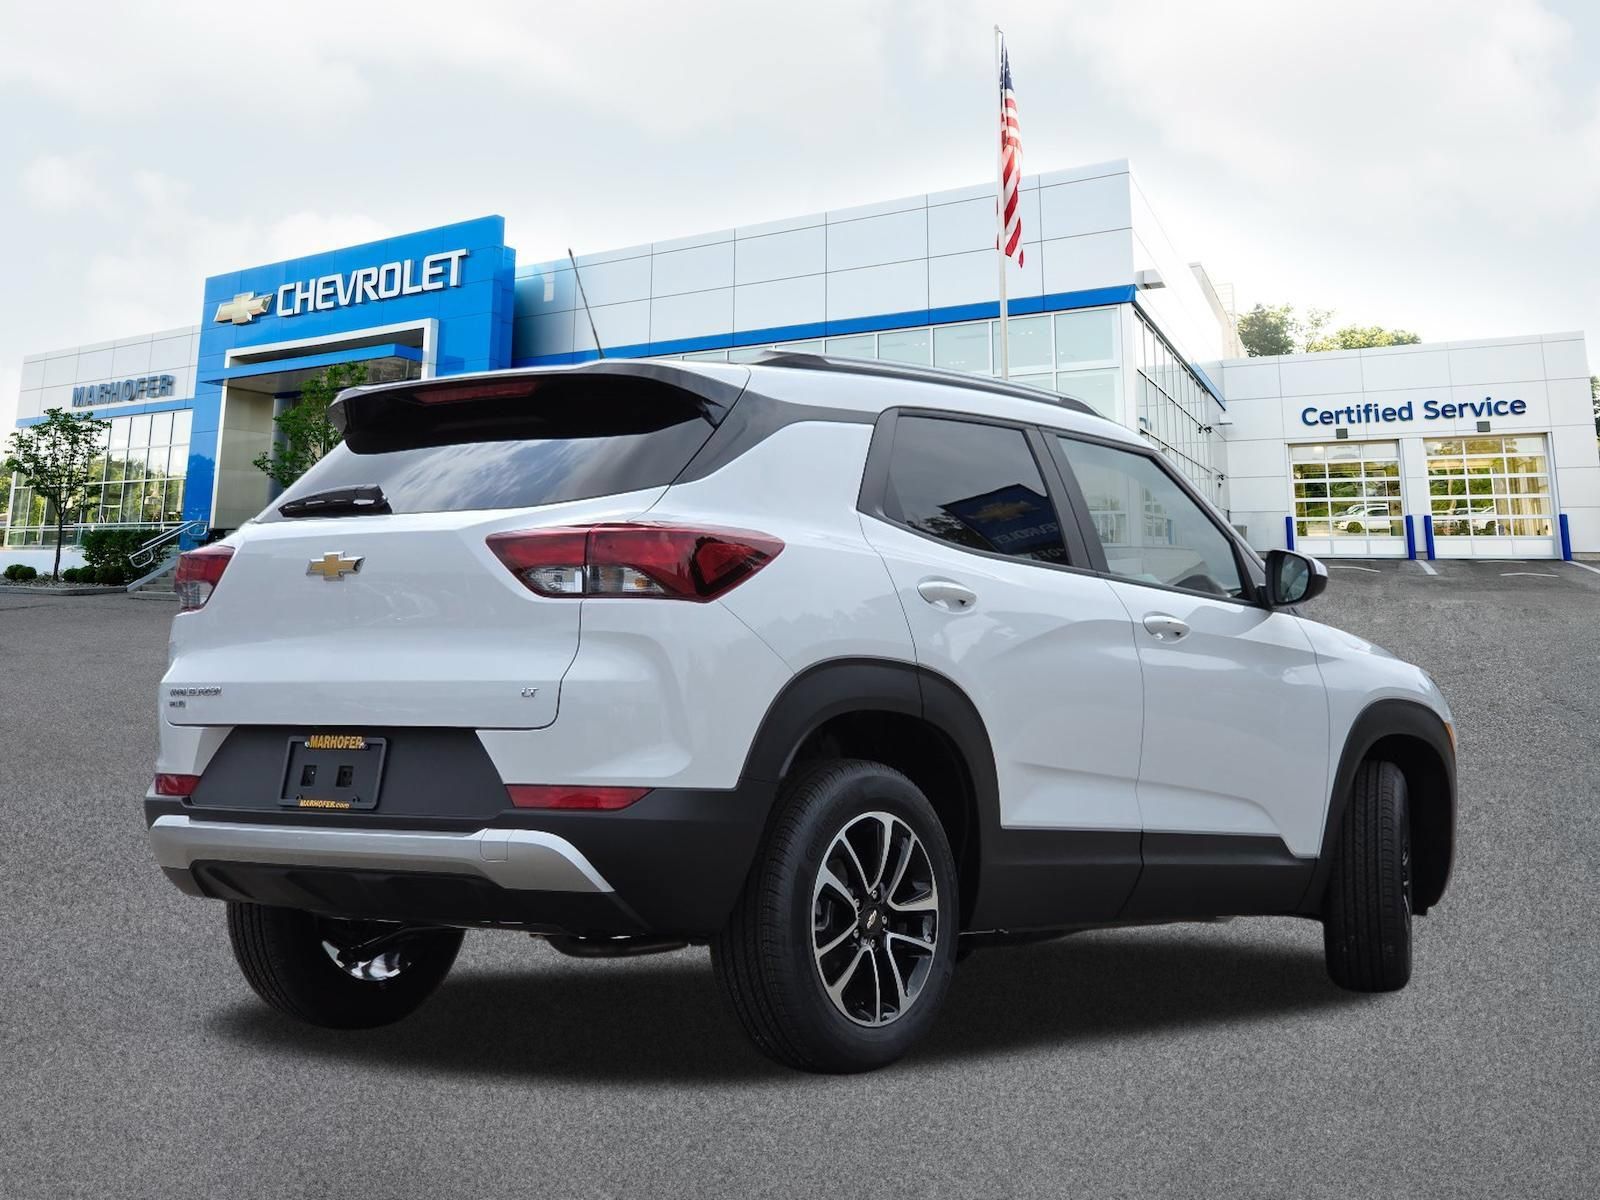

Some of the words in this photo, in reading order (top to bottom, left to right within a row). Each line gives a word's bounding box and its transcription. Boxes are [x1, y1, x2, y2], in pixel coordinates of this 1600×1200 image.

[276, 248, 469, 317] CHEVROLET
[72, 374, 176, 408] MARHOFER
[1301, 401, 1414, 427] Certified
[1424, 396, 1527, 420] Service
[520, 687, 540, 698] LT
[308, 735, 366, 749] MARHOFER
[299, 799, 350, 809] MARHOFER.com
